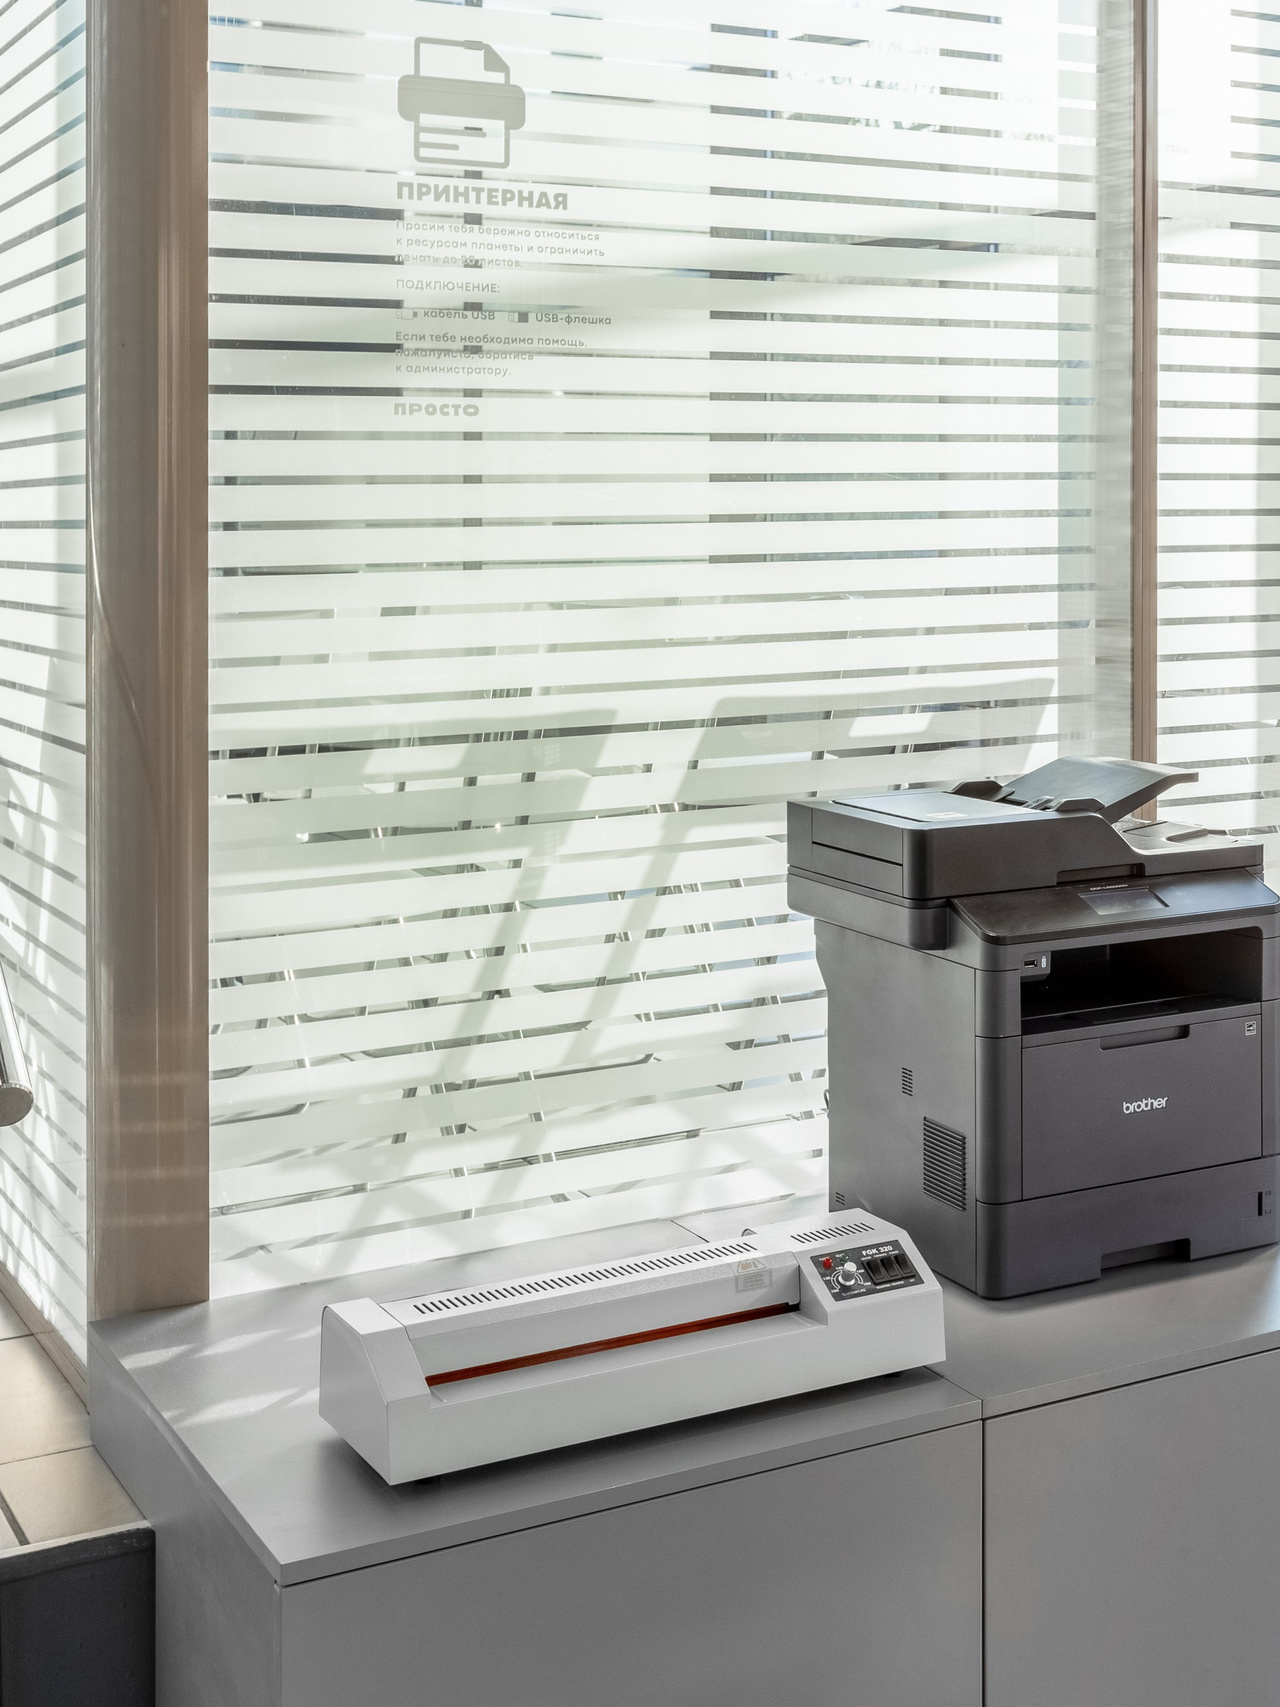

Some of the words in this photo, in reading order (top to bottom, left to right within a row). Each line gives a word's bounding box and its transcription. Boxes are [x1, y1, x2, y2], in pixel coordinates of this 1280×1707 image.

[396, 181, 569, 210] ПРИНТЕРНАЯ
[396, 219, 445, 232] Просим
[448, 223, 474, 234] тебя
[478, 224, 531, 237] бережно
[534, 230, 600, 241] относиться
[406, 238, 467, 249] ресурсам
[471, 241, 523, 252] планеты
[537, 245, 605, 257] ограничить
[395, 253, 438, 264] печать
[442, 256, 459, 265] до
[395, 279, 500, 293] ПОДКЛЮЧЕНИЕ:
[423, 309, 468, 320] кабель
[471, 310, 496, 320] USB
[535, 313, 612, 325] USB-флешка
[395, 331, 426, 342] Если
[429, 332, 457, 343] тебе
[460, 333, 534, 346] необходима
[537, 337, 588, 348] помощь,
[395, 348, 475, 360] пожалуйста,
[477, 350, 534, 361] обратись
[405, 365, 512, 377] администратору.
[393, 402, 480, 417] ПРОСТО
[1122, 1096, 1168, 1114] brother
[878, 1245, 893, 1253] 320
